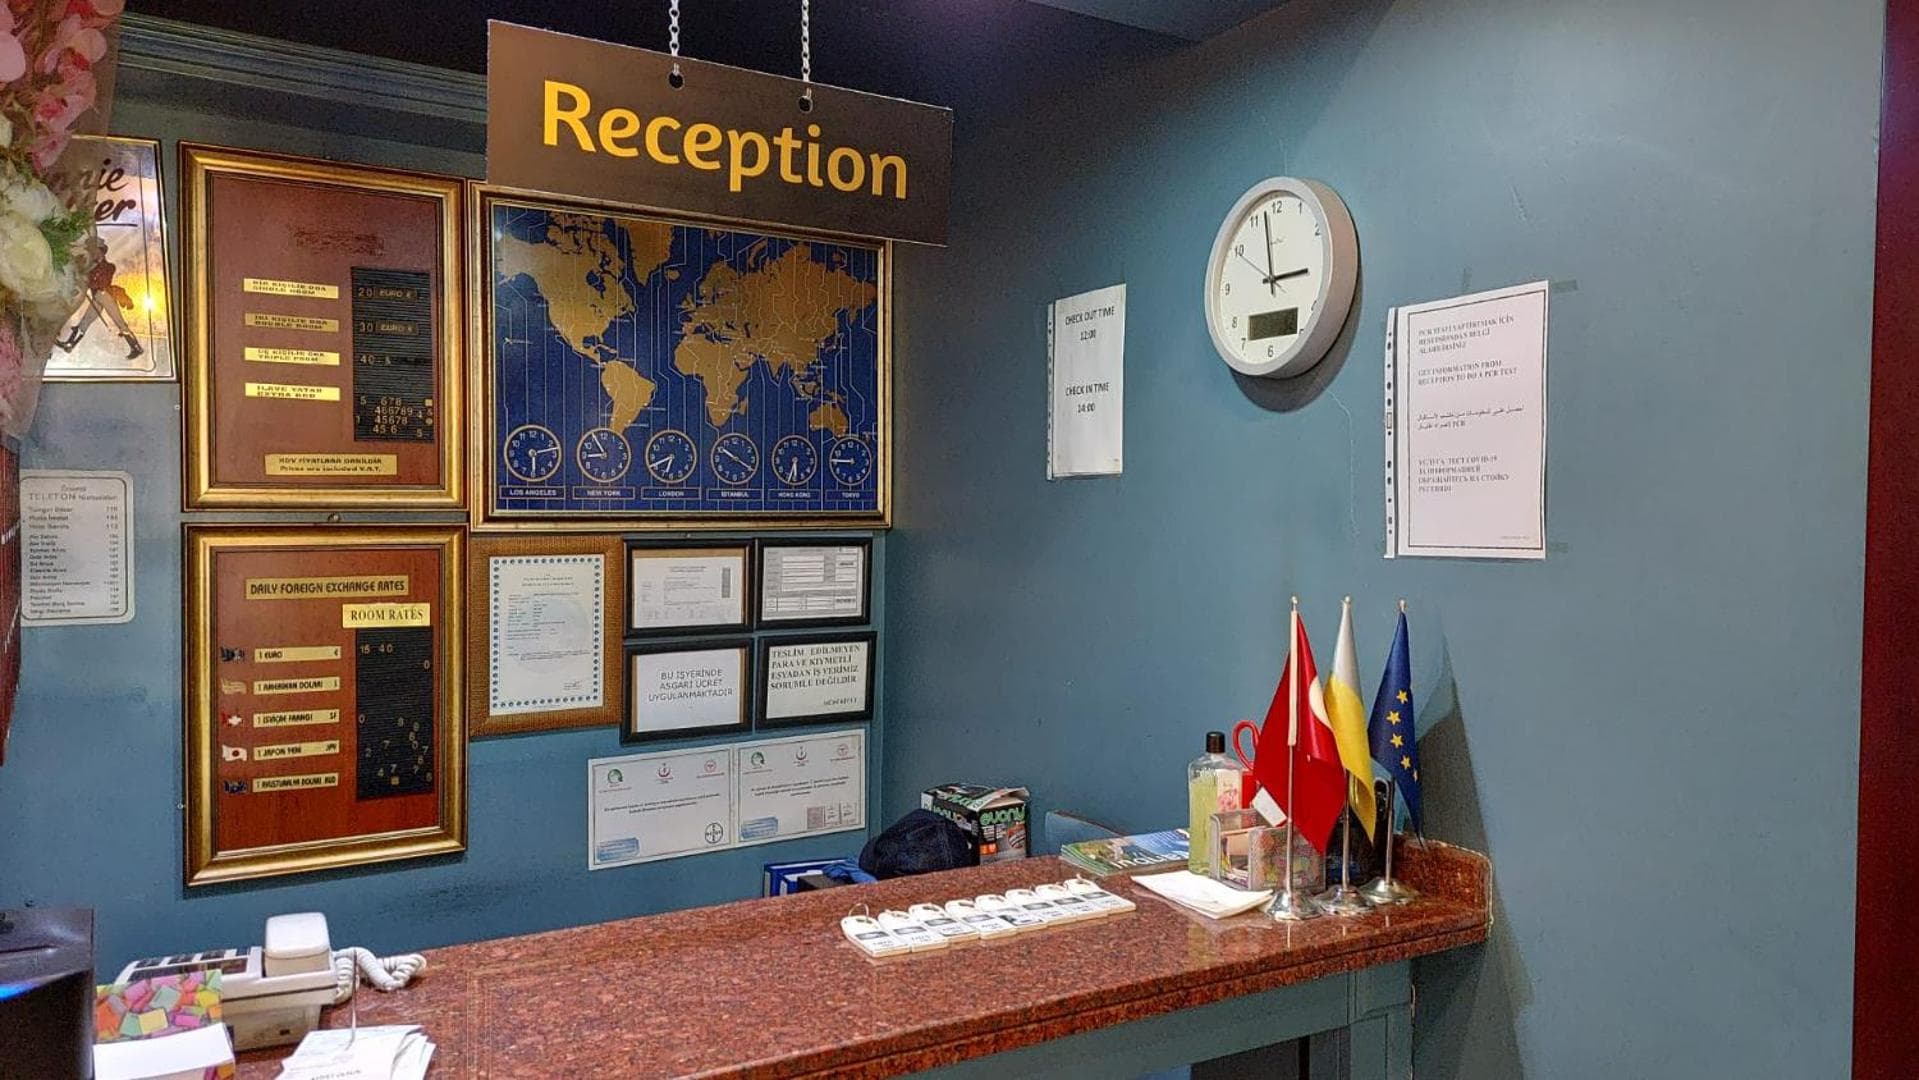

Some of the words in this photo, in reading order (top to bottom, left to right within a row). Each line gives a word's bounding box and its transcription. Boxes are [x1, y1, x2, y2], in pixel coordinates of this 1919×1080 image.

[543, 80, 907, 200] Reception
[1271, 200, 1283, 214] 12
[1298, 202, 1303, 214] 1
[1250, 215, 1259, 228] 11
[1315, 223, 1321, 237] 2
[1234, 244, 1245, 258] 10
[1224, 283, 1231, 296] 9
[1065, 312, 1084, 326] CHECK
[1084, 309, 1097, 321] OUT
[1098, 305, 1115, 318] TIME
[1232, 316, 1238, 329] 8
[1241, 338, 1247, 351] 7
[1268, 345, 1274, 358] 6
[1065, 385, 1085, 397] CHECK
[1086, 384, 1093, 395] IN
[1094, 382, 1110, 393] TIME
[250, 583, 278, 596] DAILY
[280, 582, 324, 595] FOREIGN
[326, 581, 376, 593] EXCHANGE
[377, 580, 405, 592] RATES
[351, 609, 385, 621] ROOM
[389, 608, 424, 621] RATES
[772, 661, 794, 670] PARA
[661, 671, 674, 681] BU
